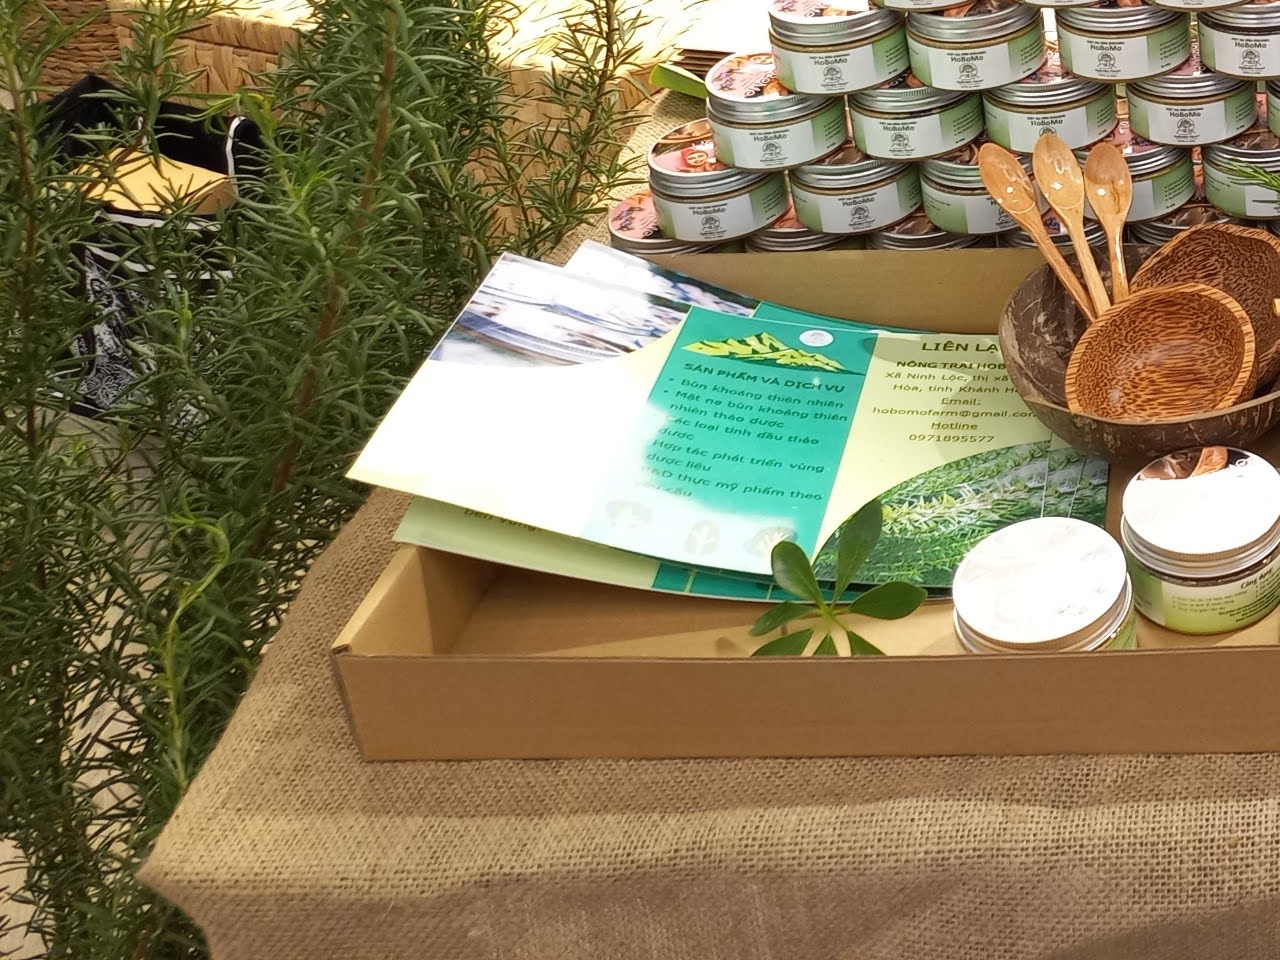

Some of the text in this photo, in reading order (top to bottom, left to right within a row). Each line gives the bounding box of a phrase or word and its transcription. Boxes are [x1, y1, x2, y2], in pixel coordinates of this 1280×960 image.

[1090, 44, 1122, 52] HoBoMo
[1234, 42, 1267, 50] HoBoMo
[814, 56, 848, 66] HoBoMo
[950, 54, 984, 64] HoBoMo
[1170, 110, 1201, 119] HoBoMo
[1030, 118, 1063, 127] HoBoMo
[882, 124, 915, 133] HoBoMo
[753, 134, 787, 142] HoBoMo
[842, 198, 875, 207] HoBoMo
[692, 207, 726, 216] HoBoMo
[922, 340, 1000, 354] LIÊN LẠ
[906, 372, 936, 380] Ninh
[958, 386, 1000, 394] Khánh
[712, 384, 763, 400] khoáng
[768, 392, 801, 405] thiên
[807, 398, 844, 409] nhiên
[758, 405, 808, 420] khoáng
[814, 411, 848, 422] thiên
[931, 422, 978, 430] Hotline
[908, 434, 995, 442] 0971895577
[790, 490, 823, 502] theo
